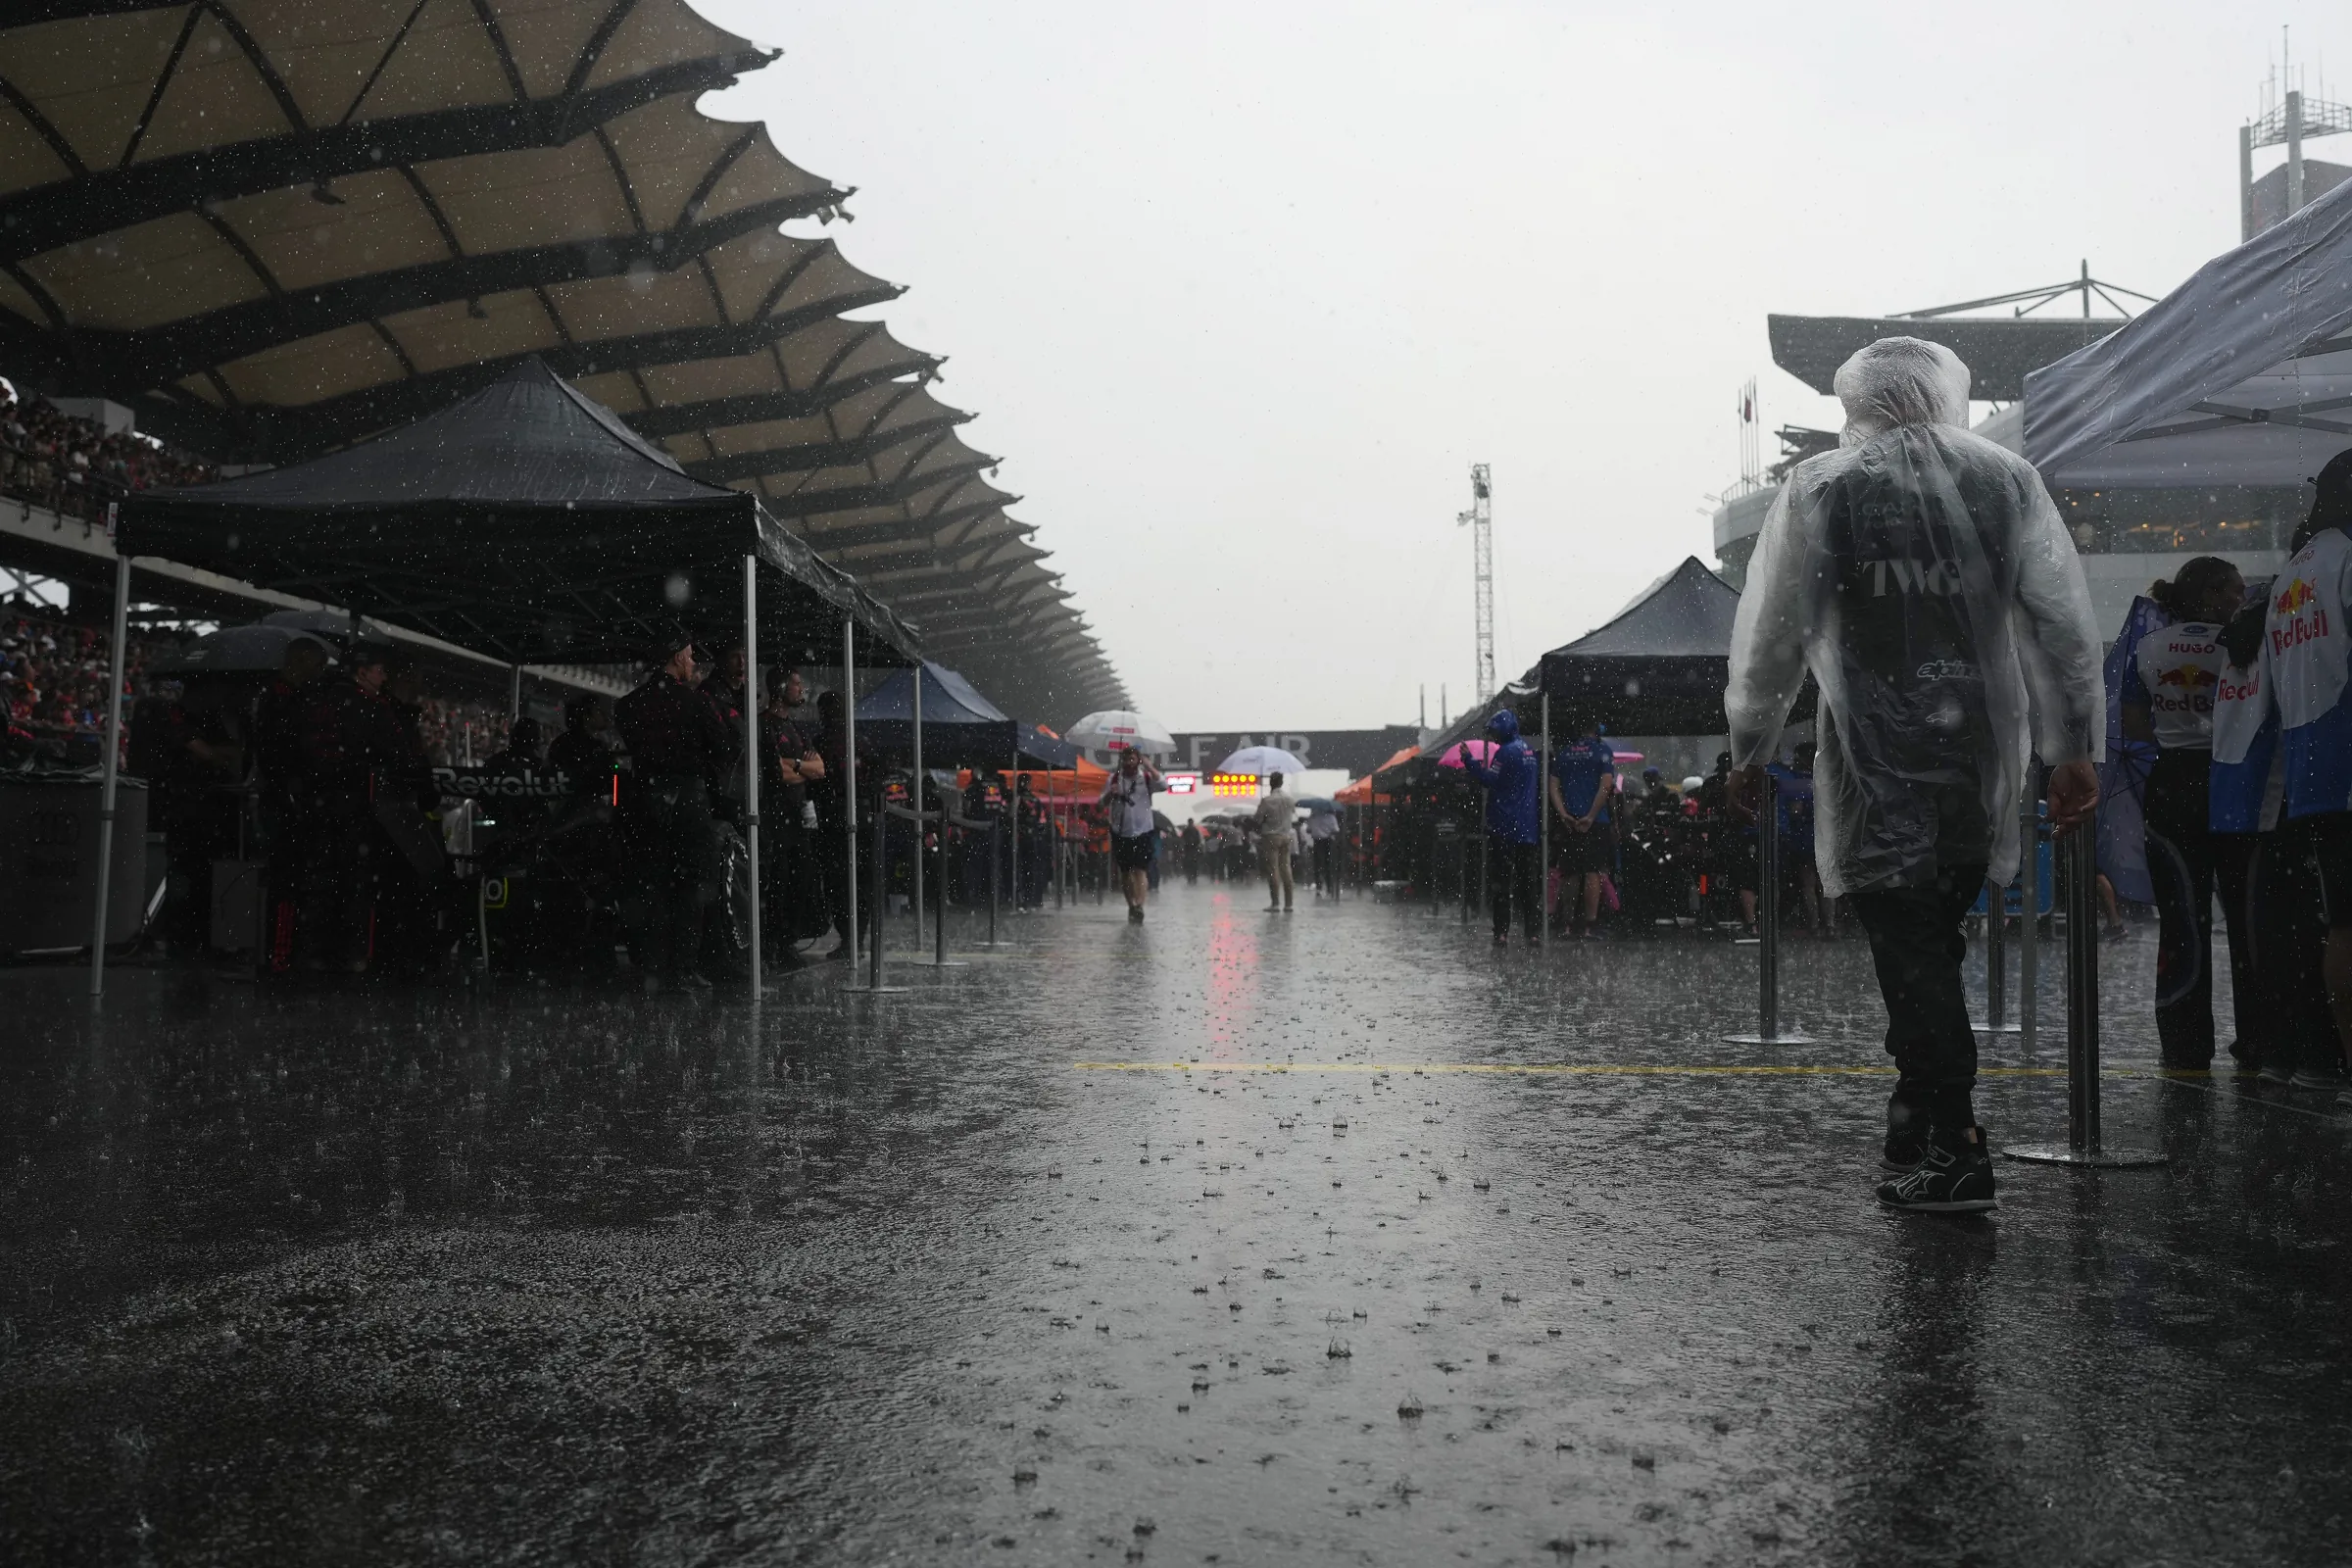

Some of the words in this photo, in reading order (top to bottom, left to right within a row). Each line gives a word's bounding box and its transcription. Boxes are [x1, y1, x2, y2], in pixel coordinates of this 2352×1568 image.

[1861, 558, 1962, 598] TWG
[2169, 643, 2216, 655] HUGO
[2153, 693, 2191, 712] Red
[431, 767, 575, 797] Revolut
